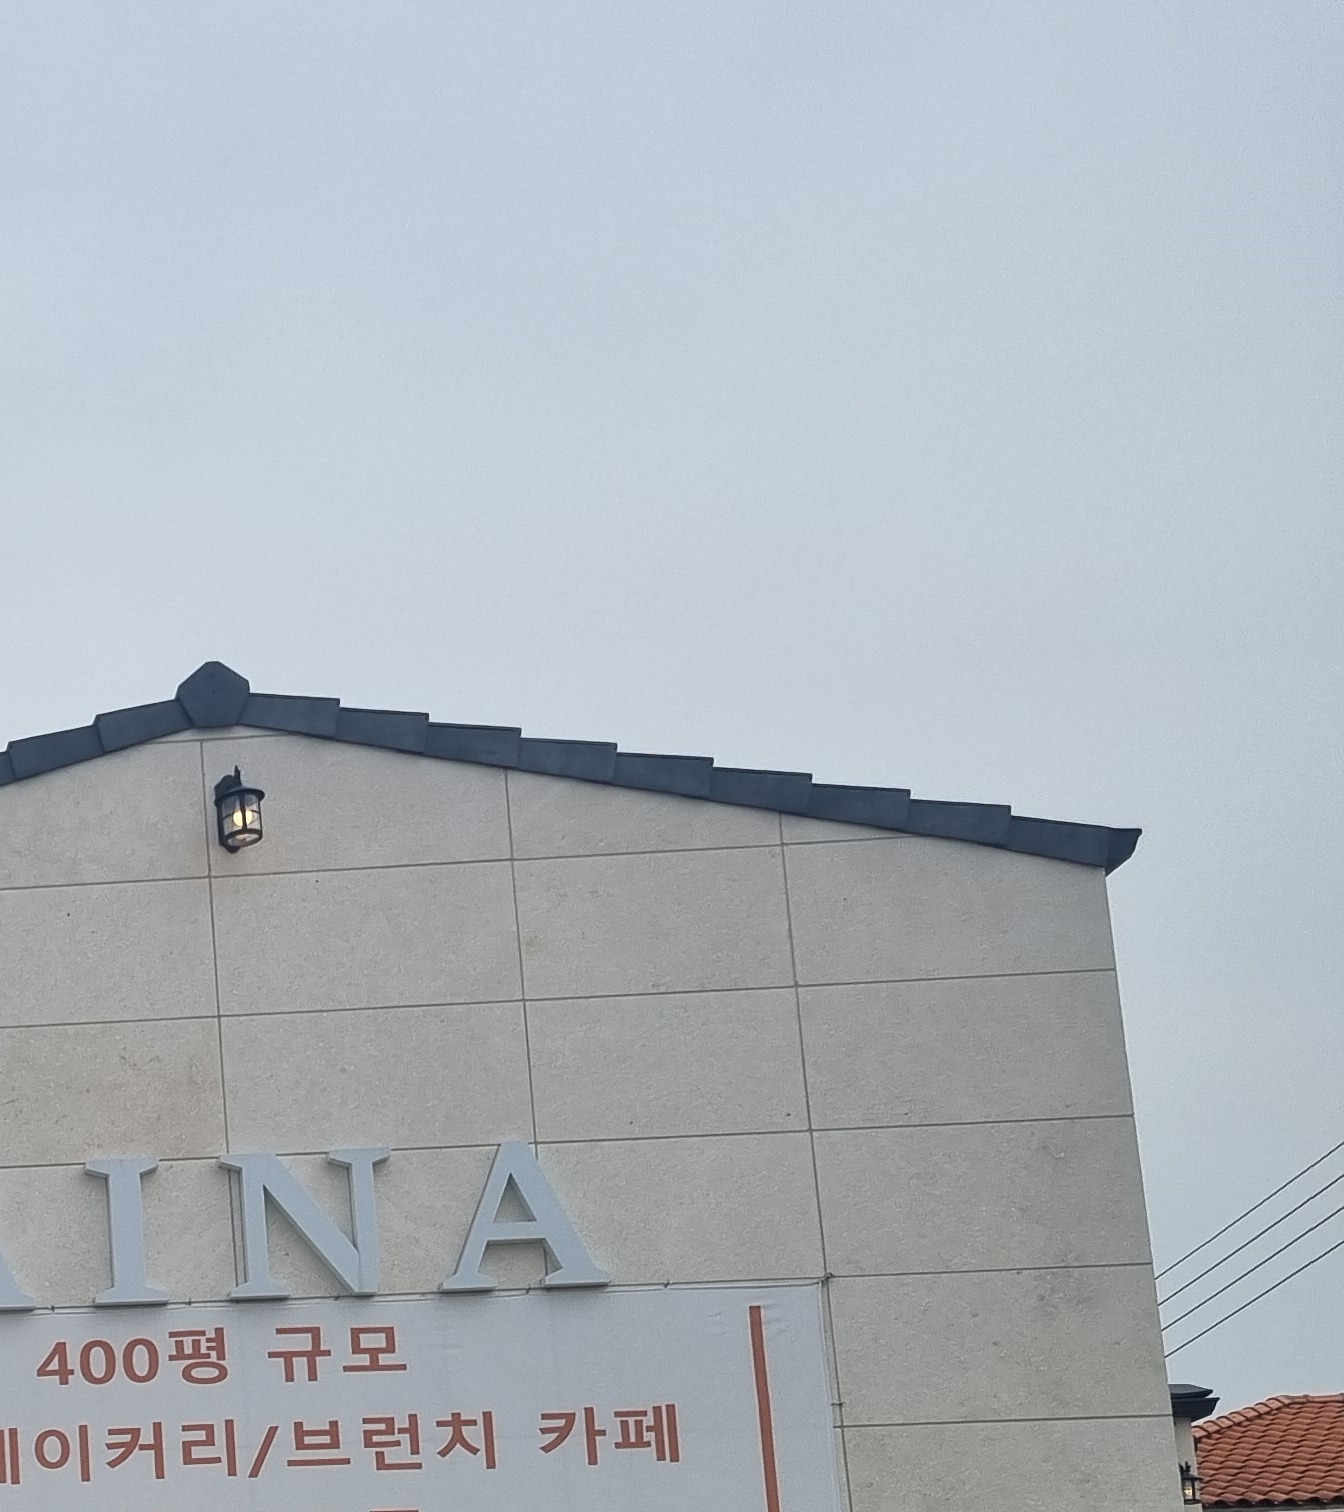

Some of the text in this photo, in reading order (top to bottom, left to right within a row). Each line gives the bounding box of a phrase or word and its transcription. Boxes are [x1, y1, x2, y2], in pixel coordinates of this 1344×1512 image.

[35, 1325, 407, 1388] 400평 규모
[540, 1403, 681, 1466] 카페
